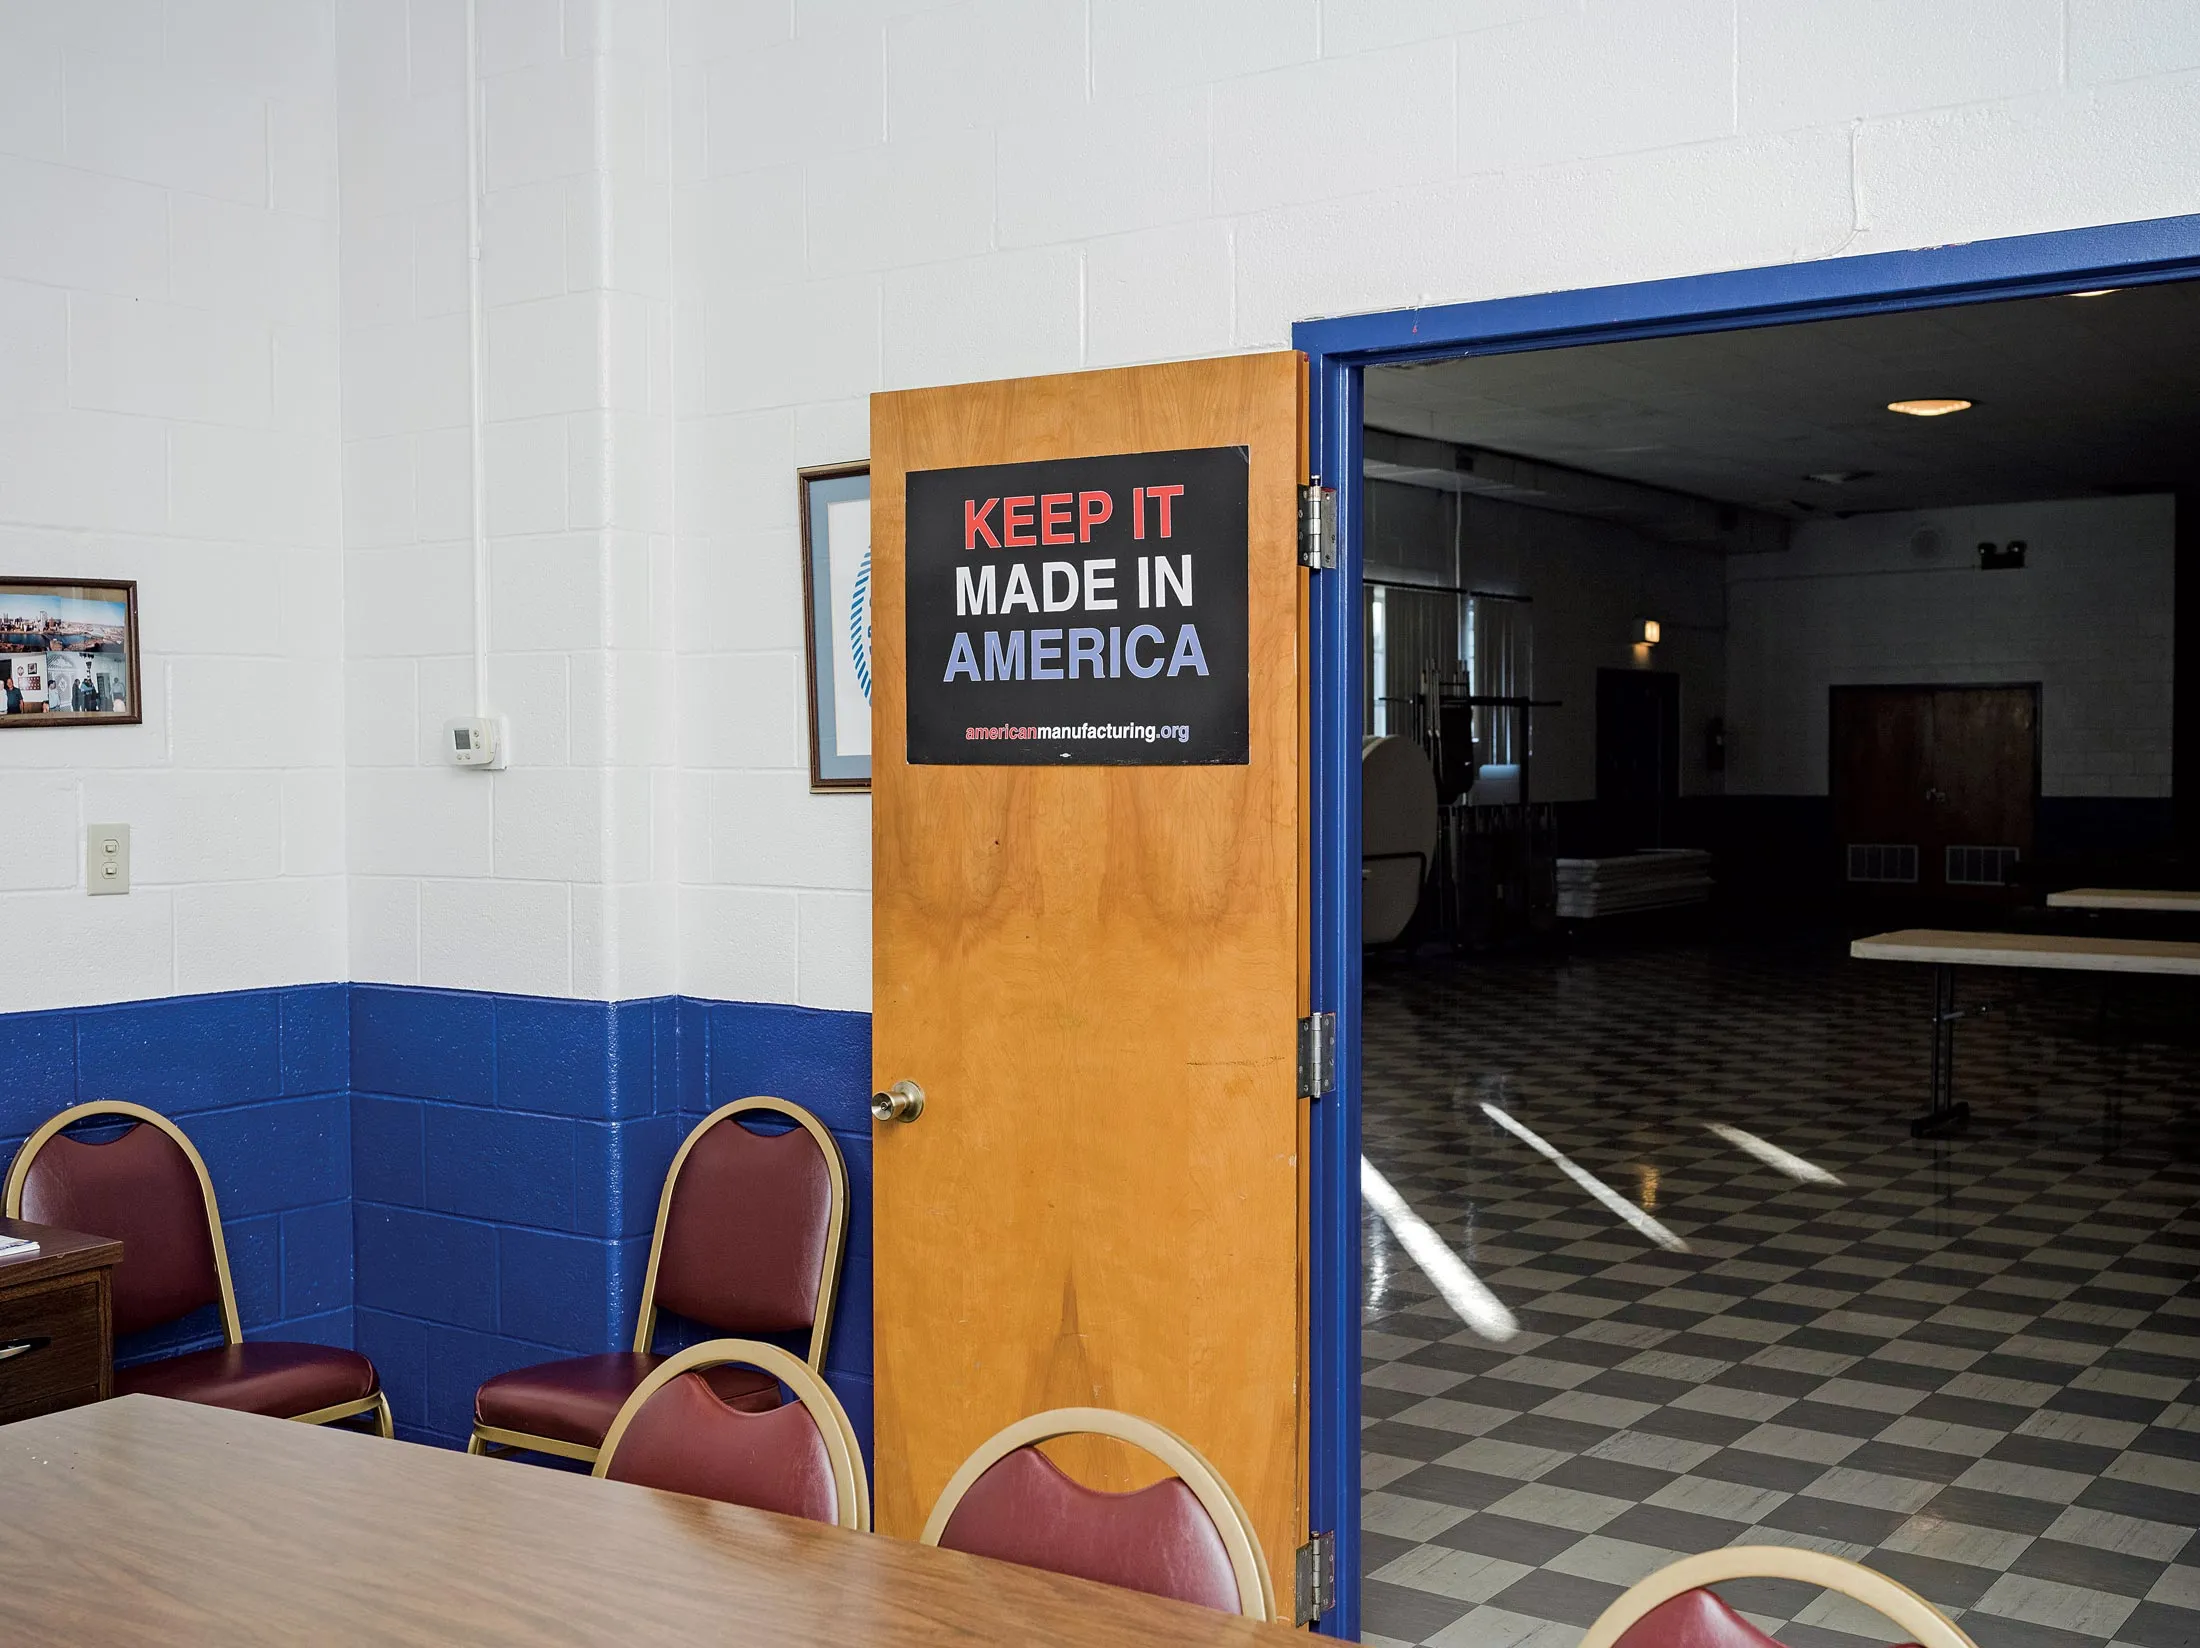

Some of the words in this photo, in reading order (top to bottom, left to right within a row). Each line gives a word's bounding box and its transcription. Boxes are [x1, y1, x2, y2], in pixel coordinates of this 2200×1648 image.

[965, 490, 1113, 549] KEEP
[1133, 485, 1184, 539] IT
[956, 558, 1118, 616] MADE
[1138, 554, 1193, 608] IN
[943, 624, 1209, 682] AMERICA
[965, 722, 1190, 742] americanmanufacturing.org
